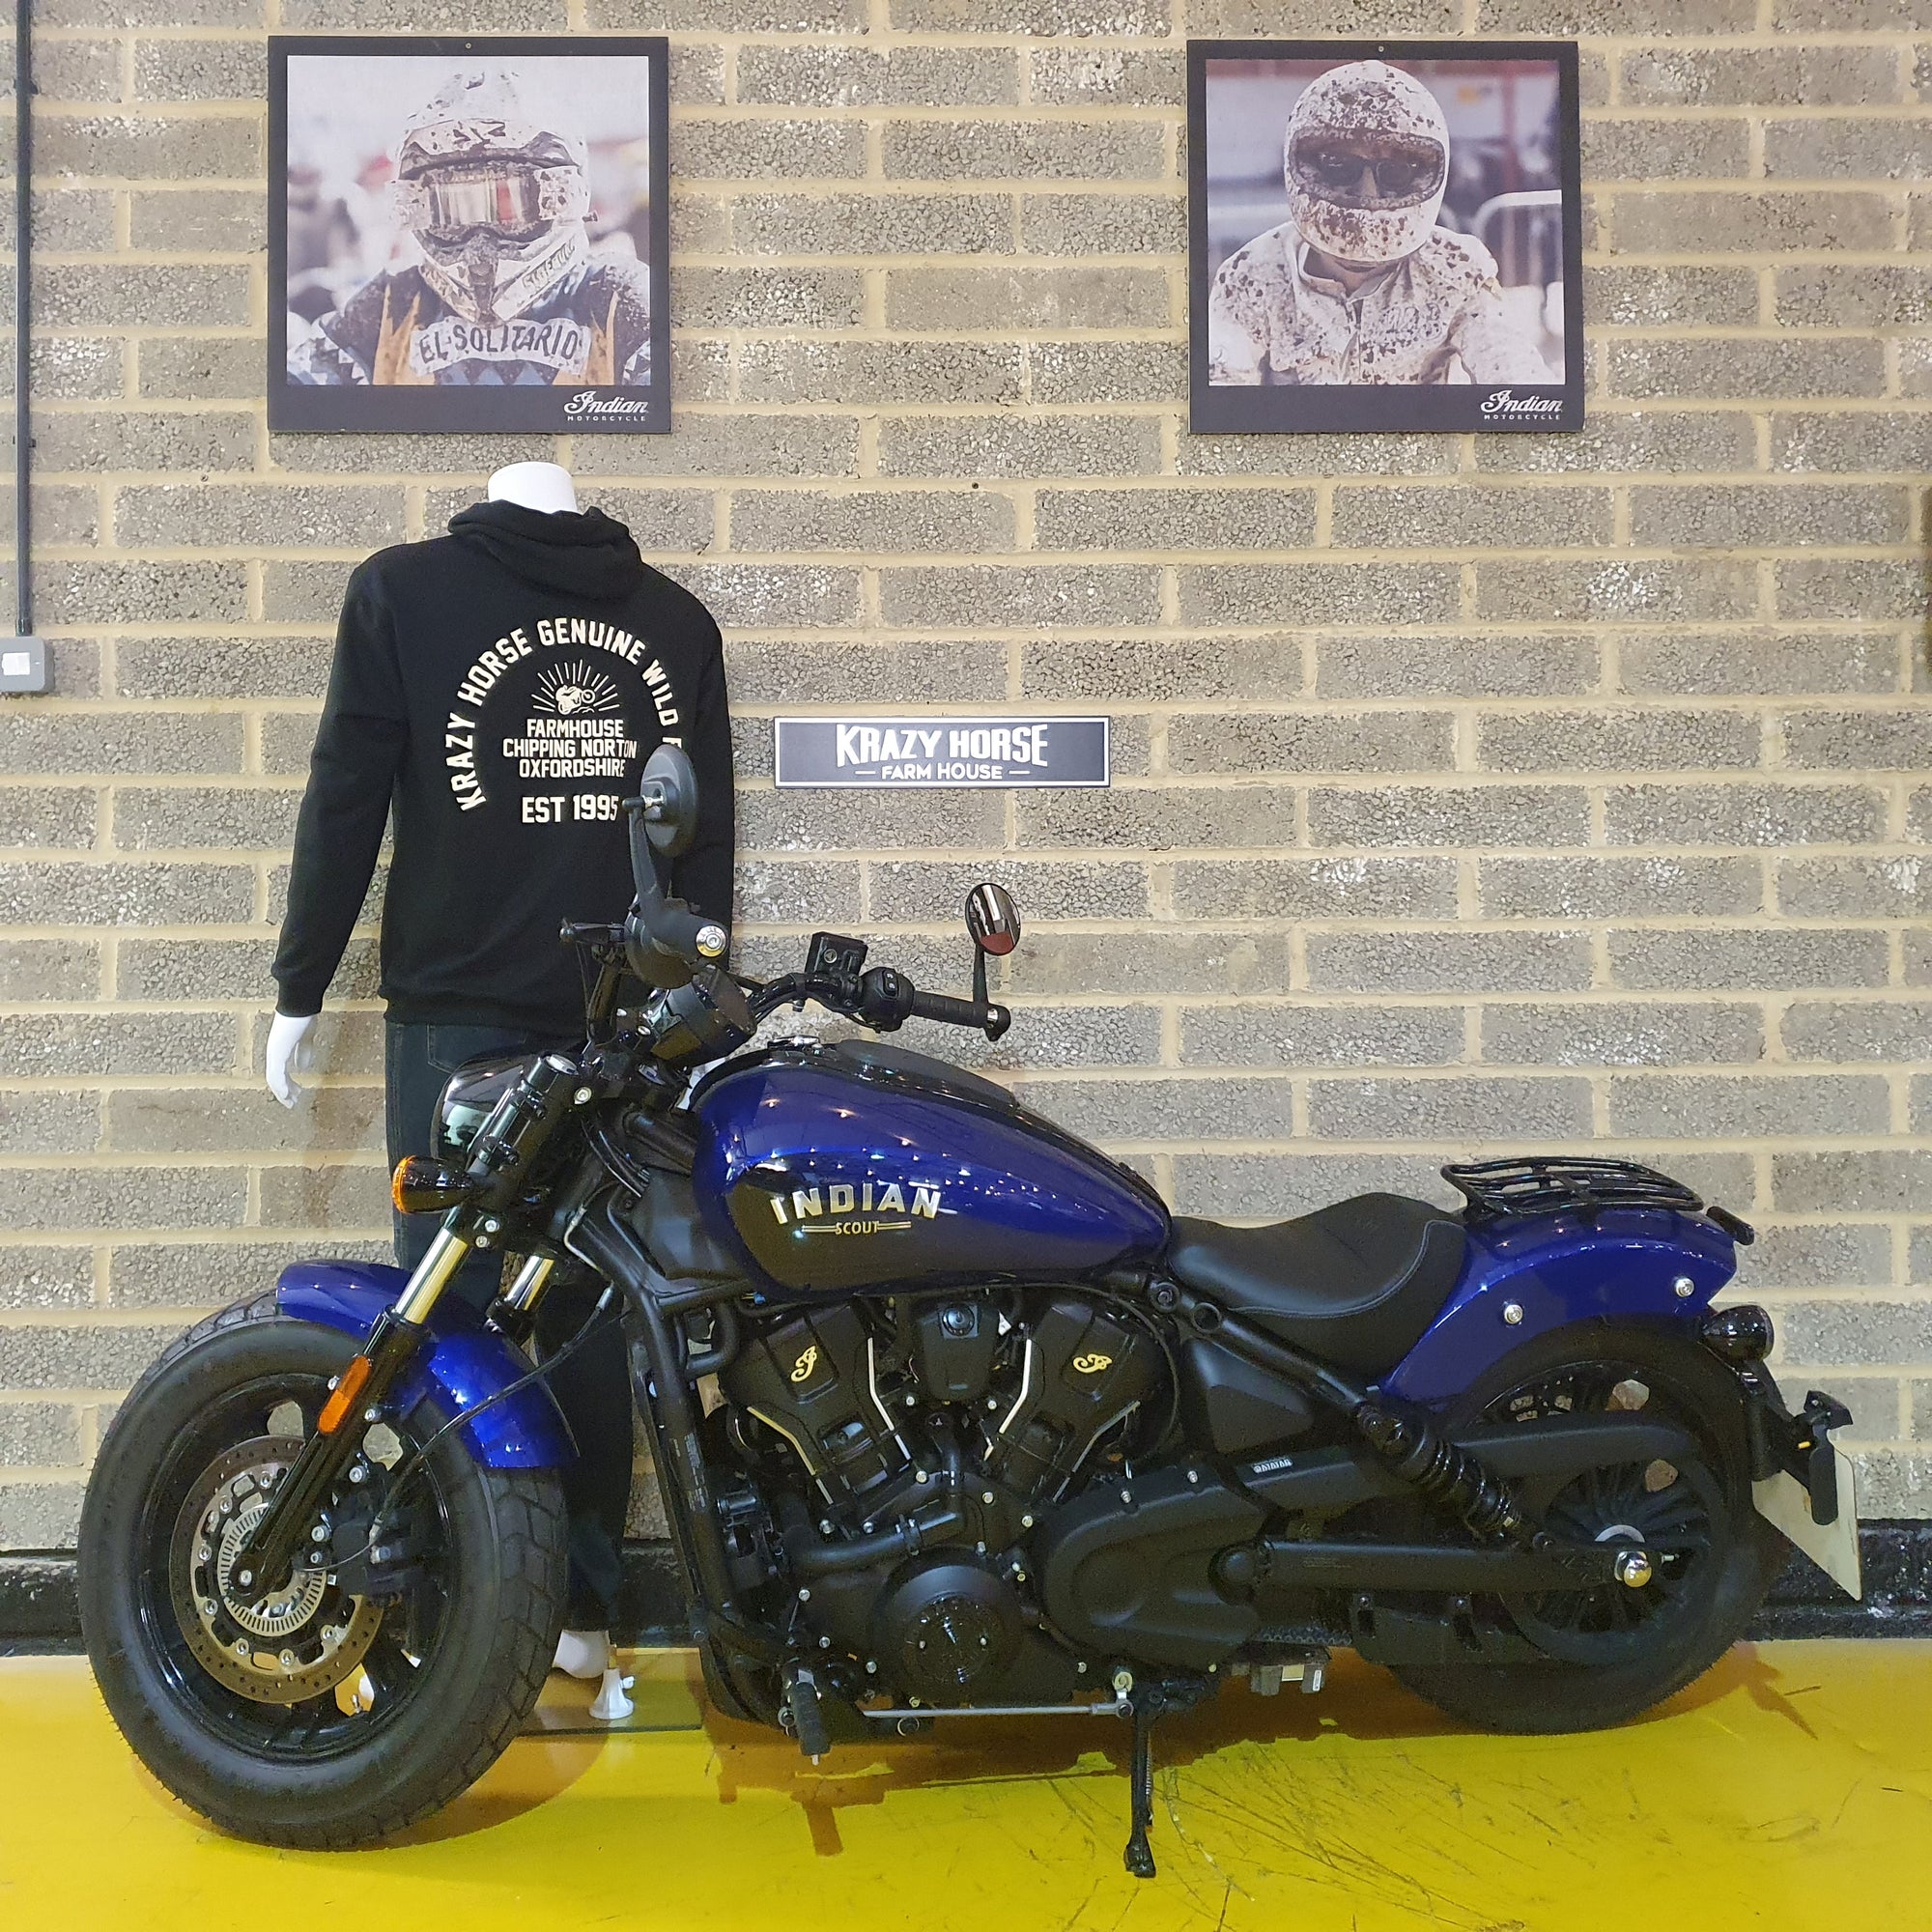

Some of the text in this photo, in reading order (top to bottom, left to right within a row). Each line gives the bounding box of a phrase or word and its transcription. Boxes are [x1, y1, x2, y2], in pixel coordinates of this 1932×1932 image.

[419, 324, 579, 364] EL SOLITARIO
[563, 390, 649, 413] Indian
[1480, 389, 1563, 412] Indian
[445, 617, 679, 811] KRAZY HORSE GENUINE WILD
[526, 719, 624, 738] FARMHOUSE
[502, 738, 638, 759] CHIPPING NORTON
[836, 724, 1048, 767] KRAZY HORSE
[519, 758, 625, 779] OXFORDSHIRE
[881, 763, 1003, 781] FARM HOUSE
[522, 794, 619, 824] EST 1995
[770, 1182, 942, 1225] INDIAN
[835, 1220, 880, 1236] SCOUT
